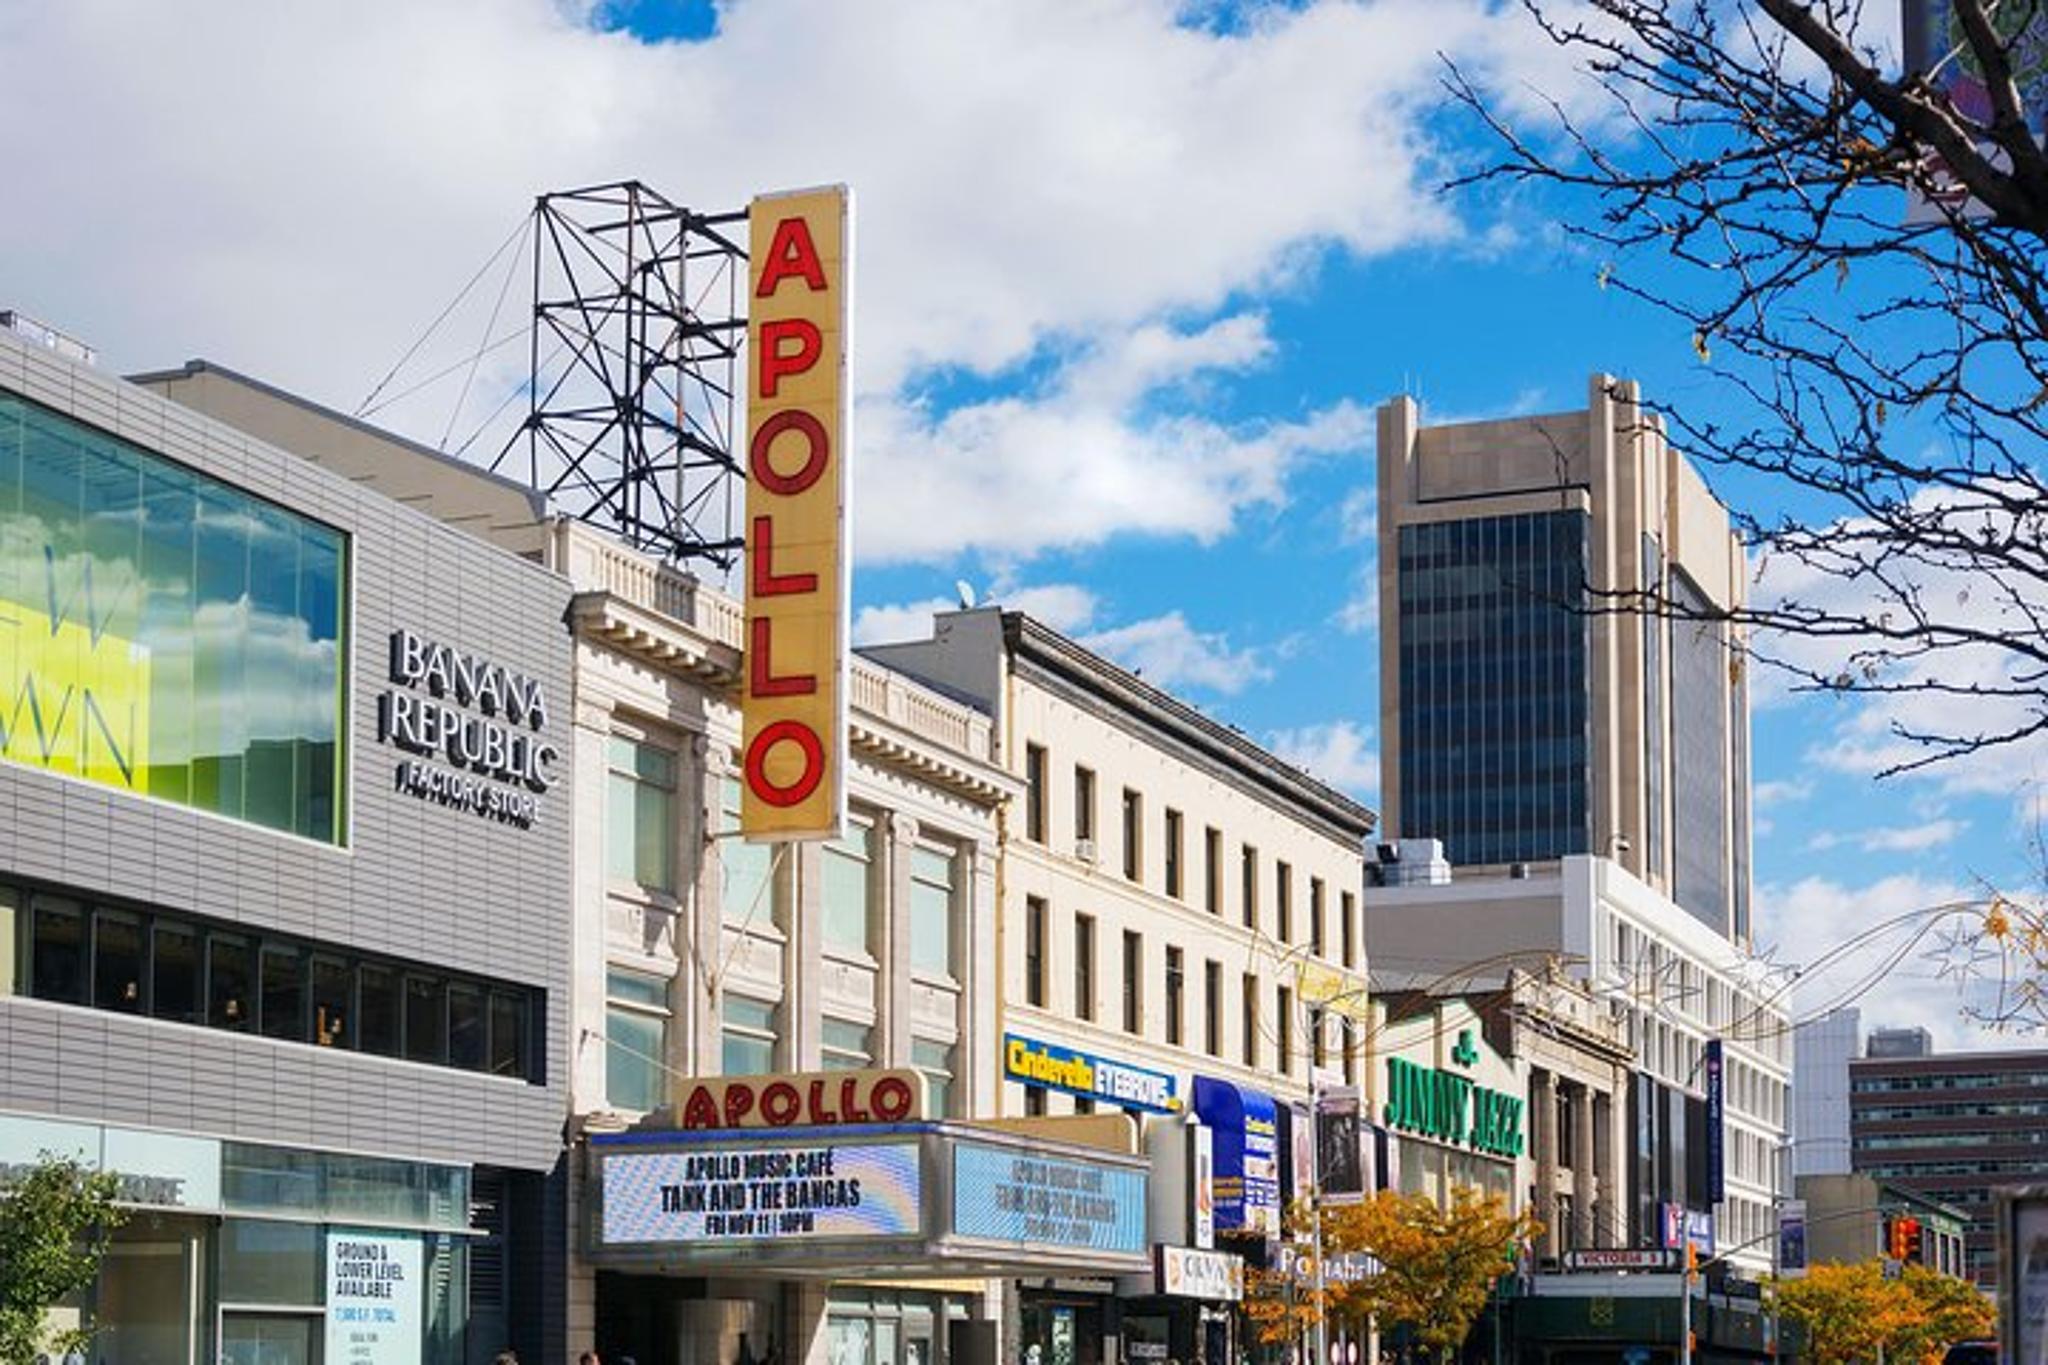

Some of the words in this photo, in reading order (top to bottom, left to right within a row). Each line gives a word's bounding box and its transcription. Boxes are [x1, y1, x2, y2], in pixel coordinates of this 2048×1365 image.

[744, 217, 829, 808] APOLLO
[394, 629, 549, 729] BANANA
[385, 689, 559, 788] REPUBLIC
[401, 761, 485, 811] FACTORY
[487, 786, 543, 825] STORE
[1007, 1040, 1095, 1092] Cinderella
[682, 1077, 912, 1129] APOLLO
[685, 1156, 740, 1180] APOLLO
[743, 1153, 792, 1178] MUSIC
[796, 1145, 834, 1176] CAFÉ
[660, 1185, 706, 1212] TANK
[710, 1182, 746, 1211] AND
[749, 1181, 783, 1209] THE
[785, 1178, 861, 1209] BANGAS
[335, 1242, 379, 1260] GROUND
[335, 1261, 373, 1279] LOWER
[375, 1263, 405, 1281] LEVEL
[335, 1280, 393, 1298] AVAILABLE
